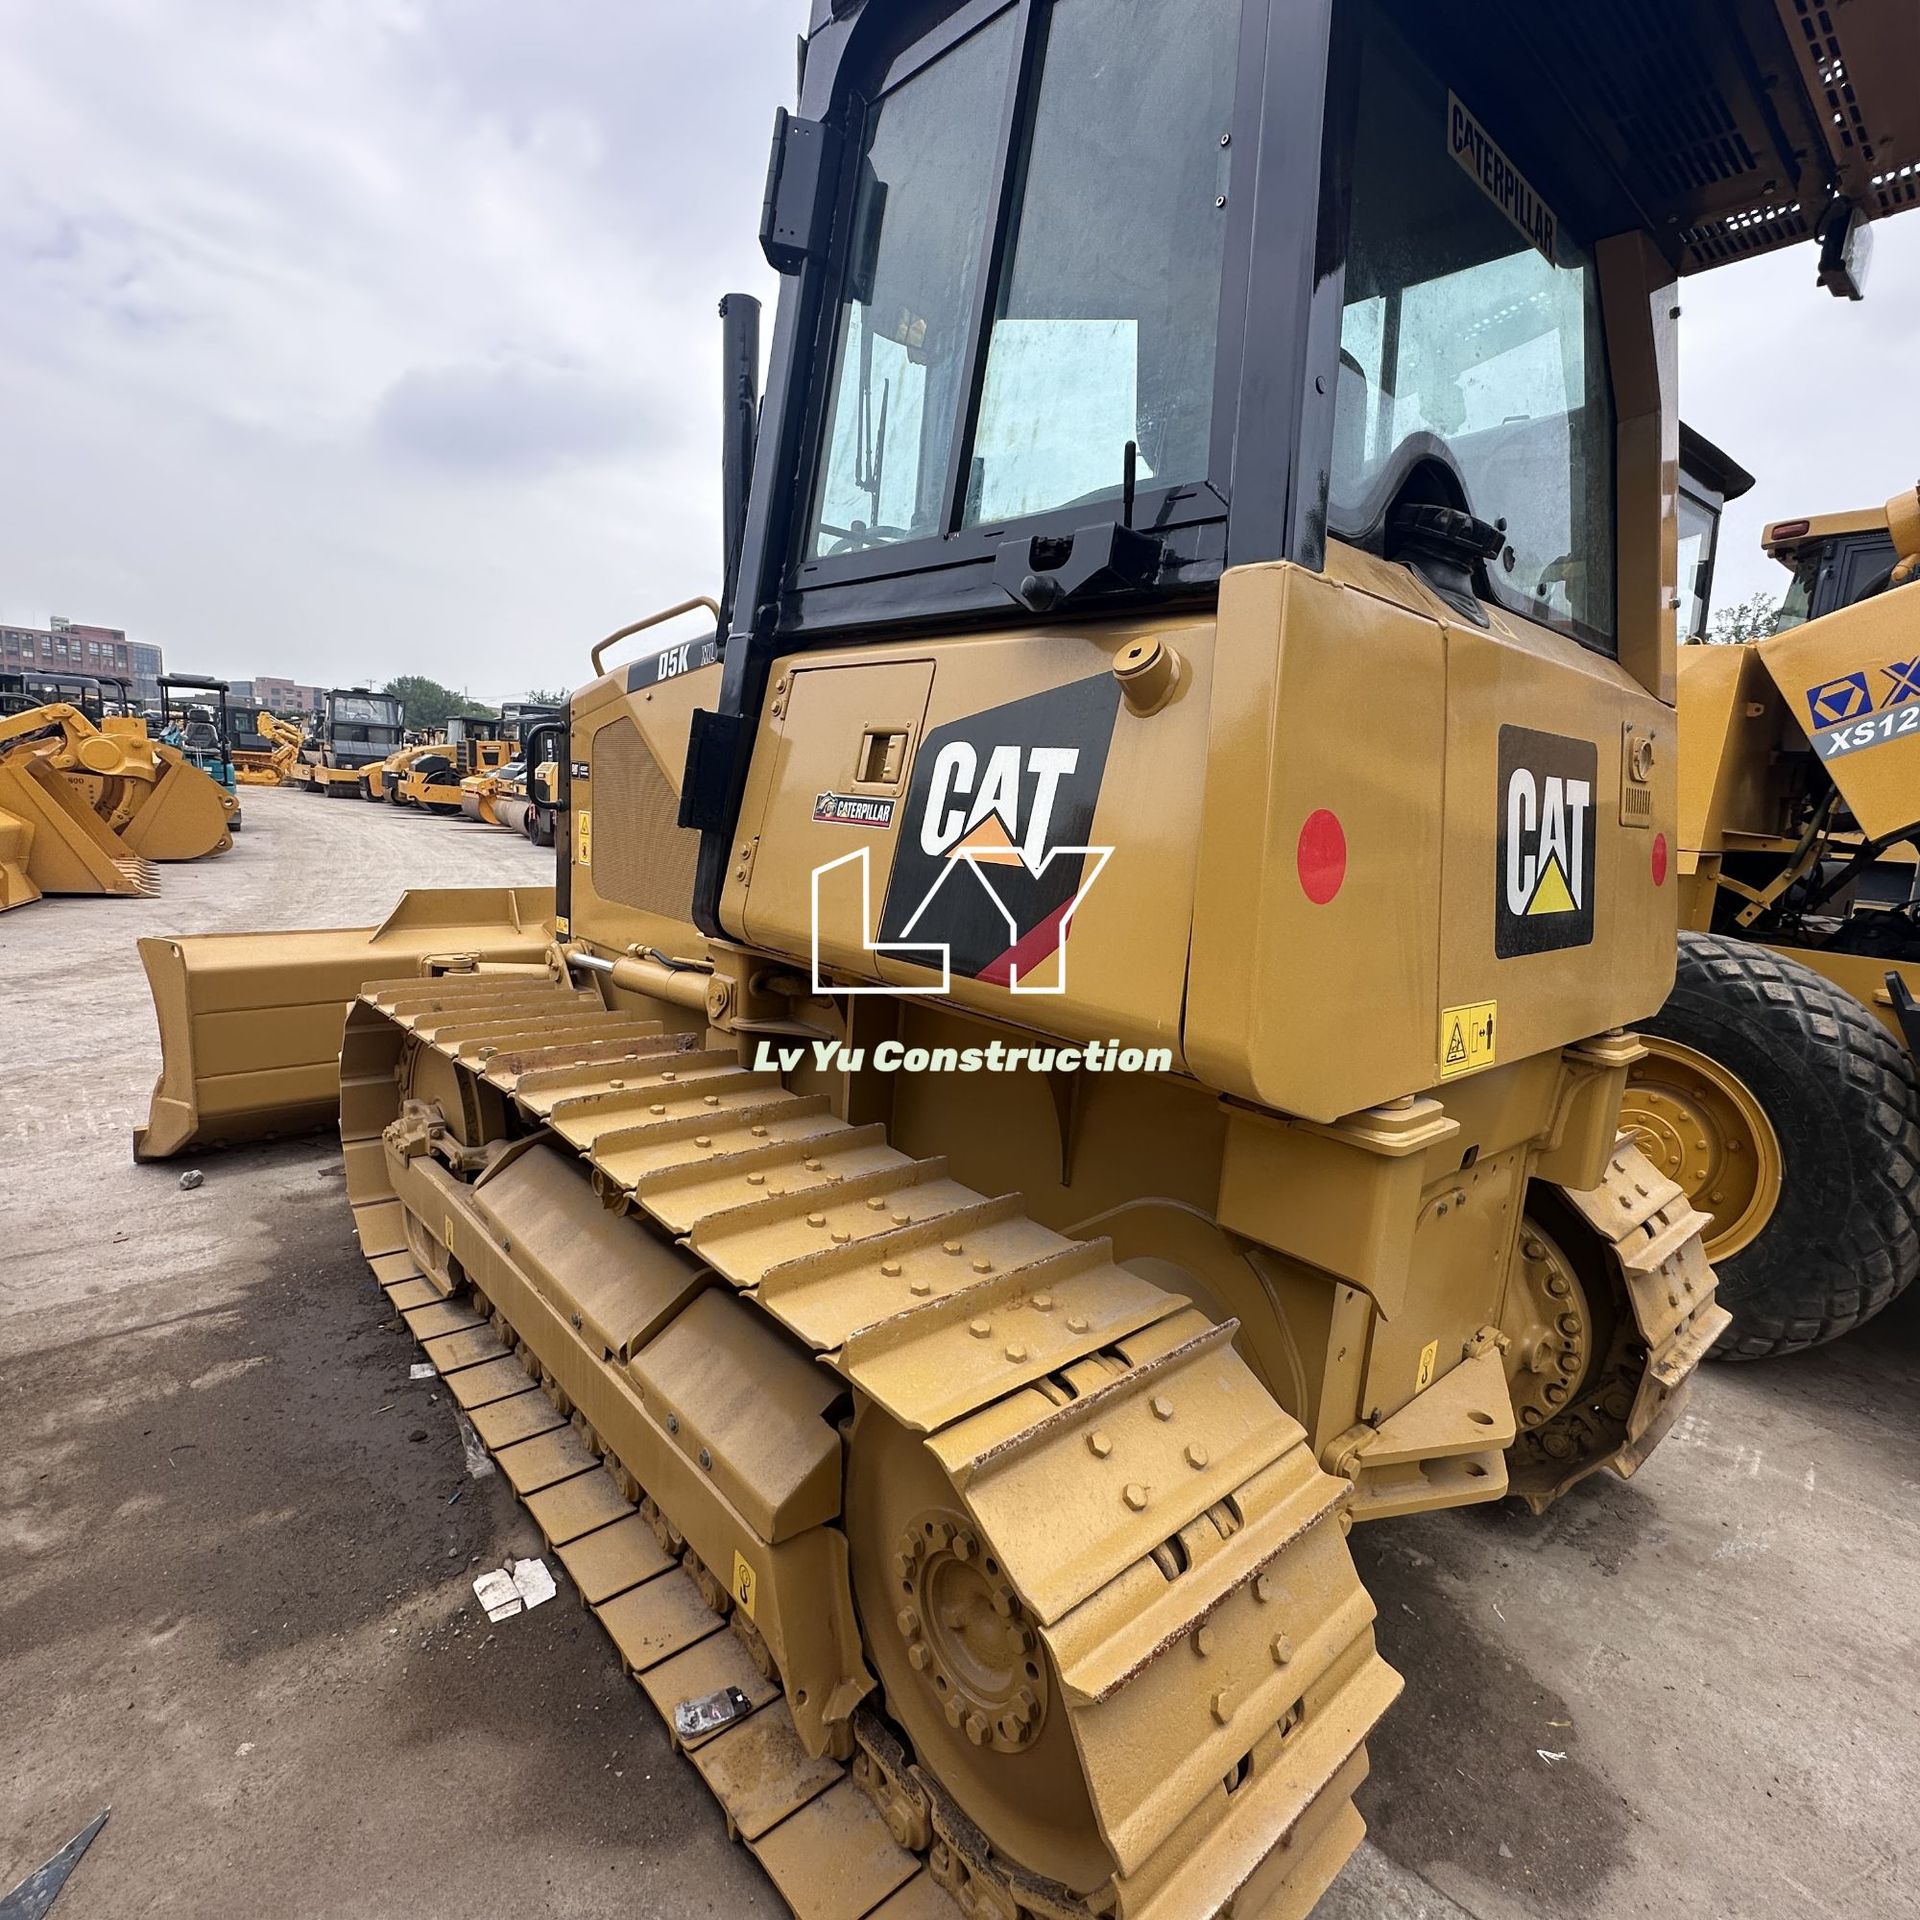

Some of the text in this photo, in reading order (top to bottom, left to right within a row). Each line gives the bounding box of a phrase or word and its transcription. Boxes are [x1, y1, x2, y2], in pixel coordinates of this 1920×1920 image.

[1452, 103, 1553, 260] CATERPILLAR
[657, 643, 691, 681] D5K
[836, 801, 891, 822] CATERPILLAR
[920, 741, 1080, 871] CAT
[1506, 768, 1590, 916] CAT
